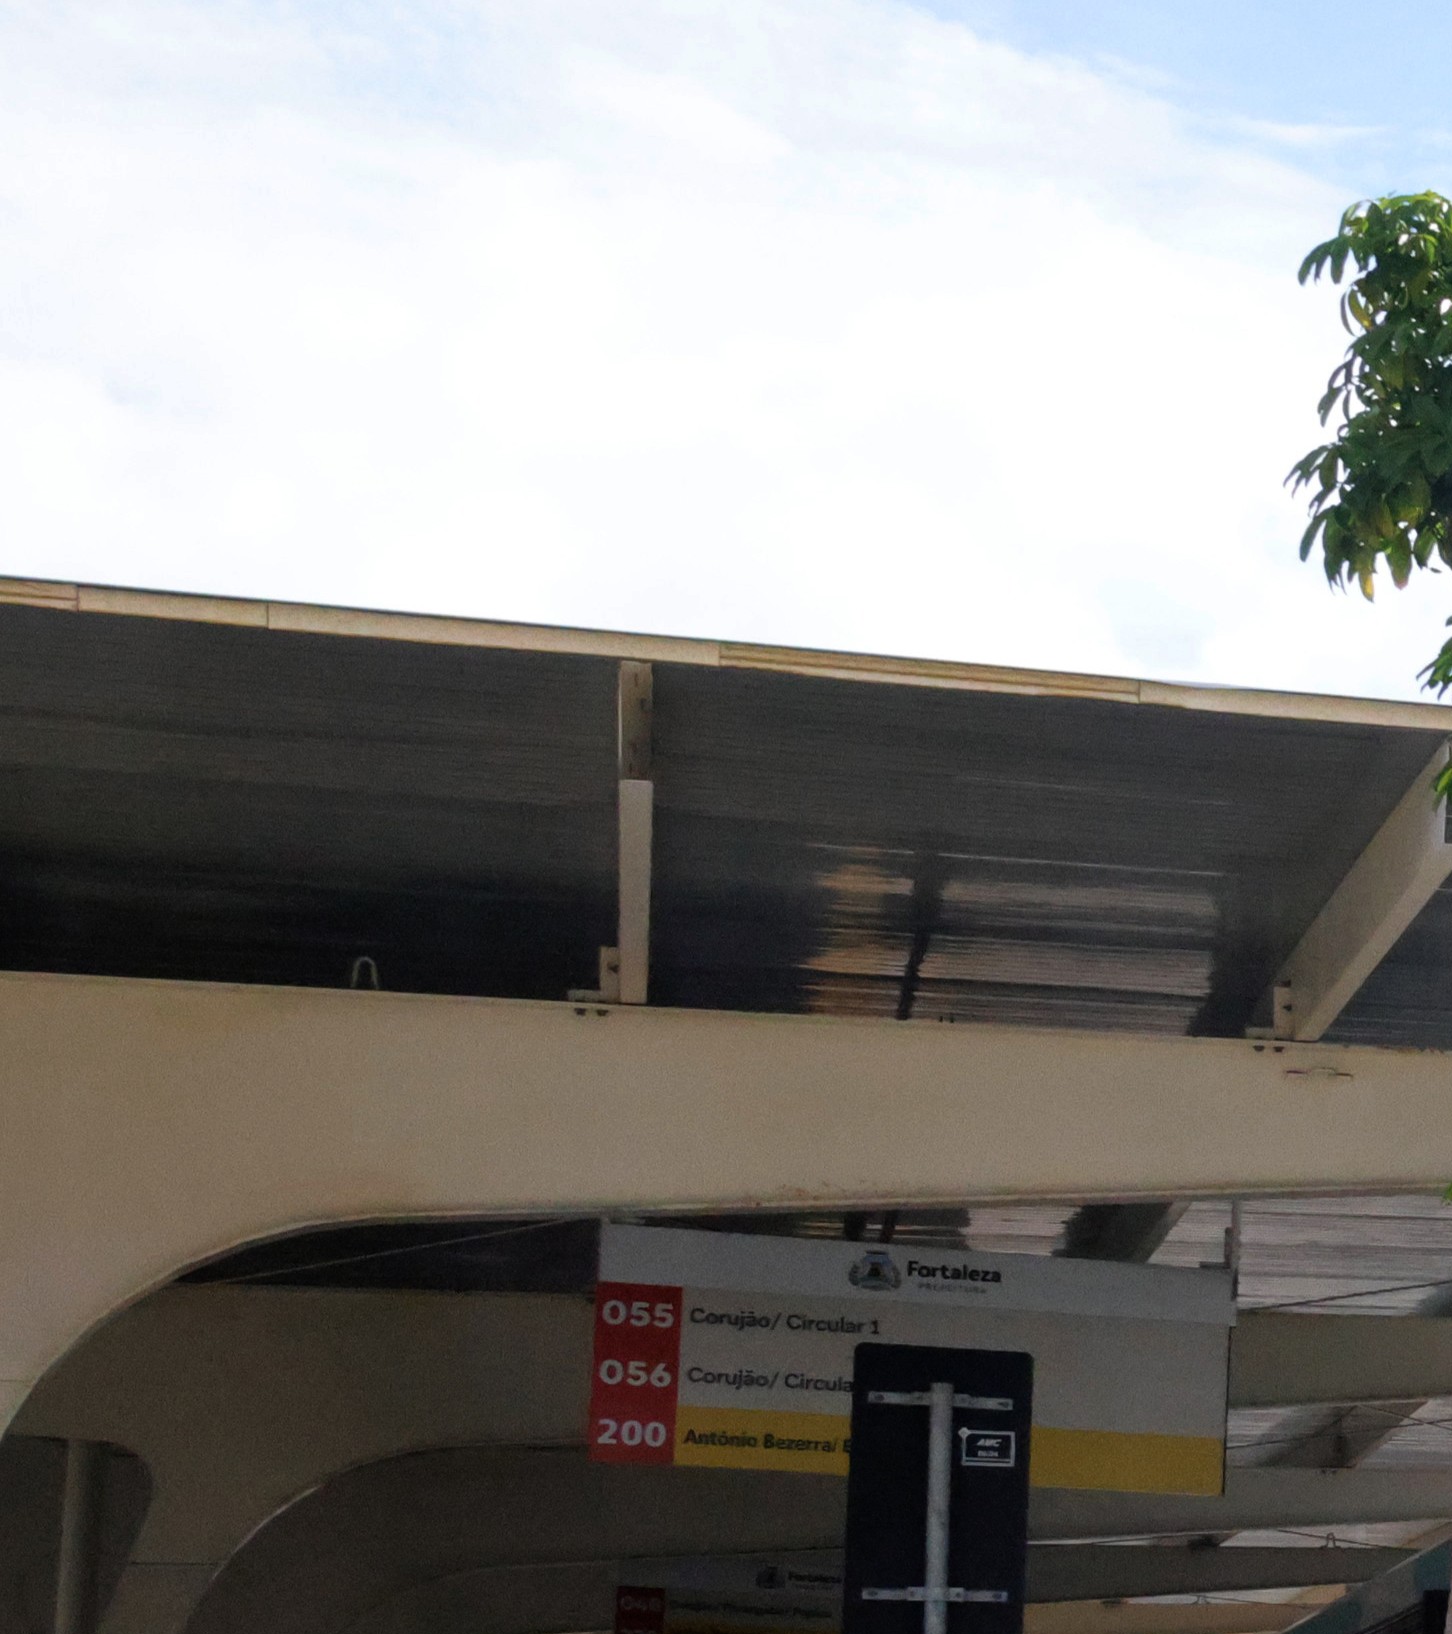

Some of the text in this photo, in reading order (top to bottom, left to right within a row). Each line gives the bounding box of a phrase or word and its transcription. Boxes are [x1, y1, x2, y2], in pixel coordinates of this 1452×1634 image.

[907, 1260, 1002, 1285] Fortaleza
[601, 1299, 675, 1329] 055
[786, 1312, 867, 1334] Circular
[869, 1320, 880, 1336] 1
[599, 1358, 672, 1389] 056
[784, 1372, 855, 1394] Circula
[596, 1417, 667, 1448] 200
